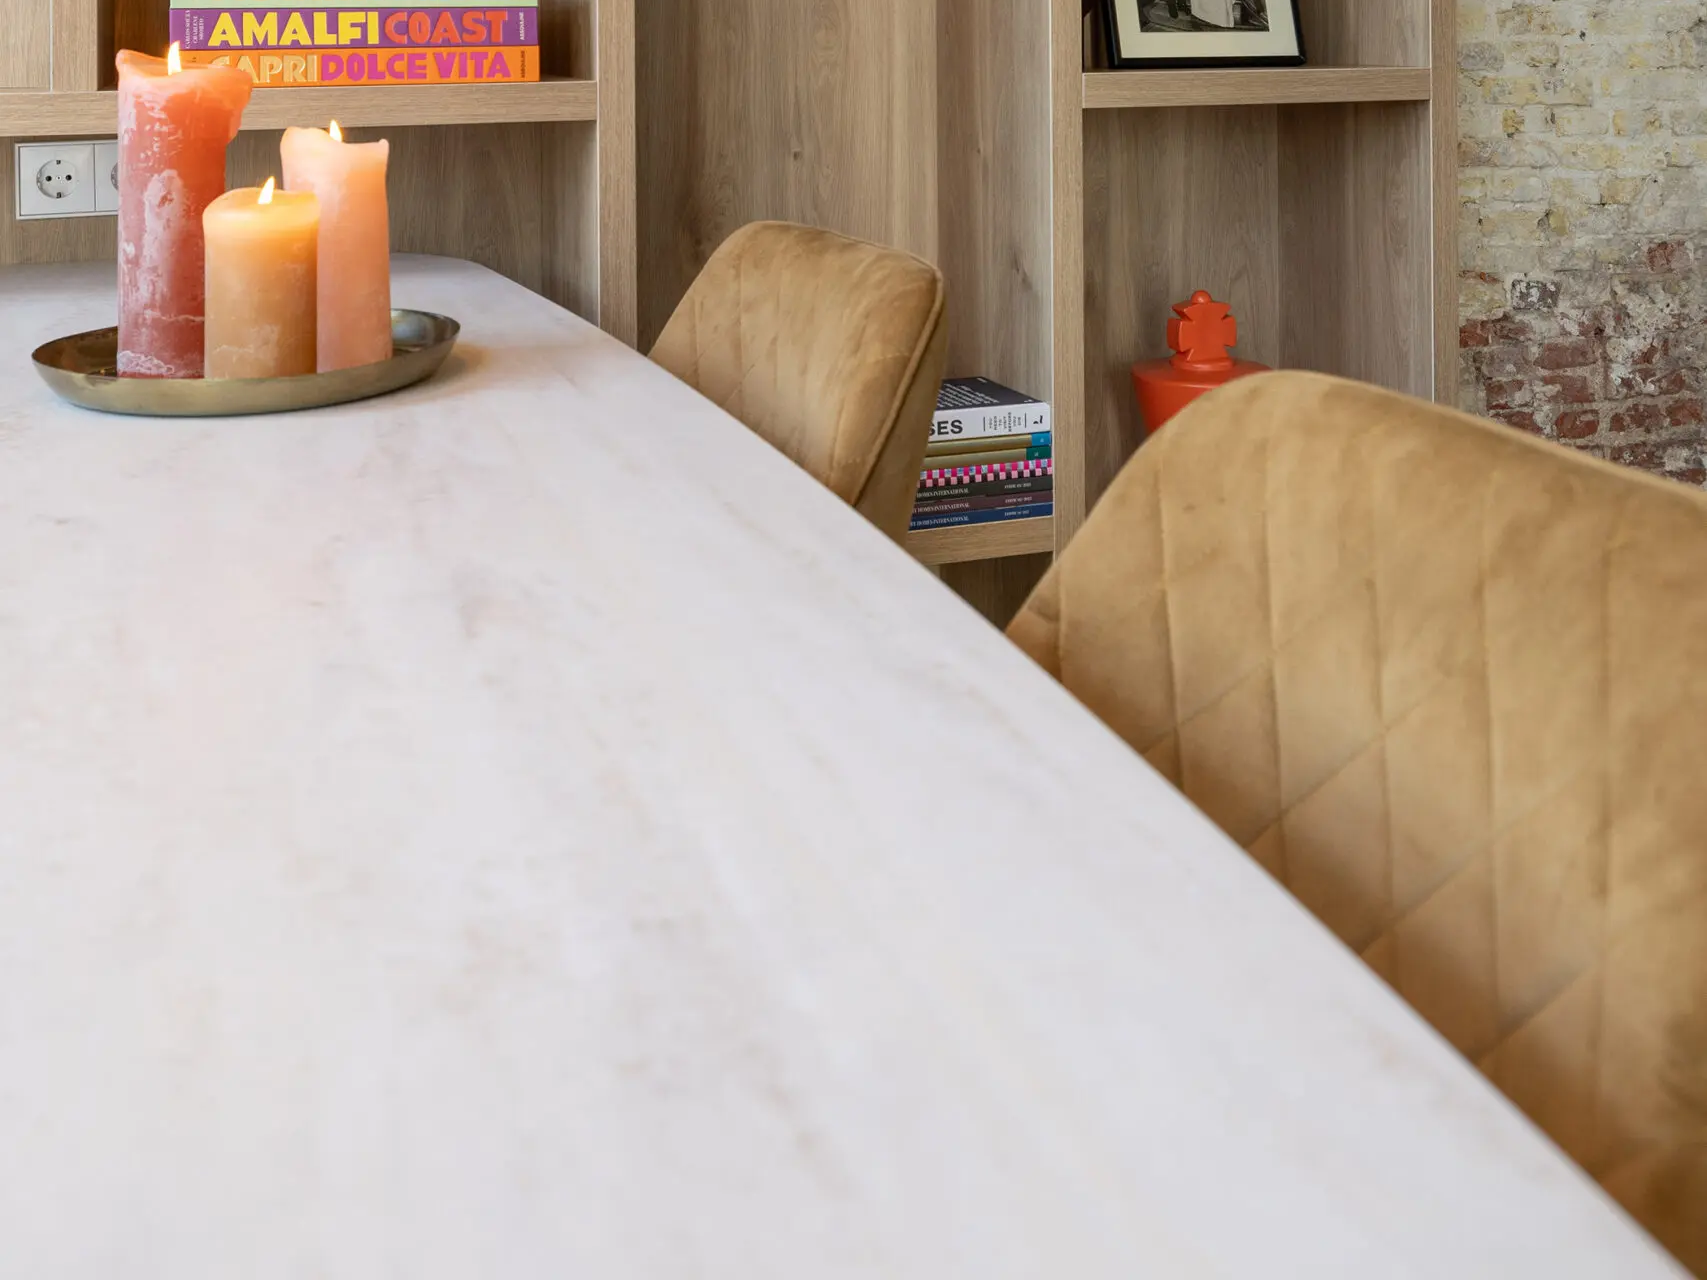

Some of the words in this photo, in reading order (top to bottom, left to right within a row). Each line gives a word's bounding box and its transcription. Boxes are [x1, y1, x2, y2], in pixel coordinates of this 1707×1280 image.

[207, 11, 380, 47] AMALFI
[384, 11, 508, 45] COAST
[321, 53, 428, 81] DOLCE
[433, 51, 512, 79] VITA
